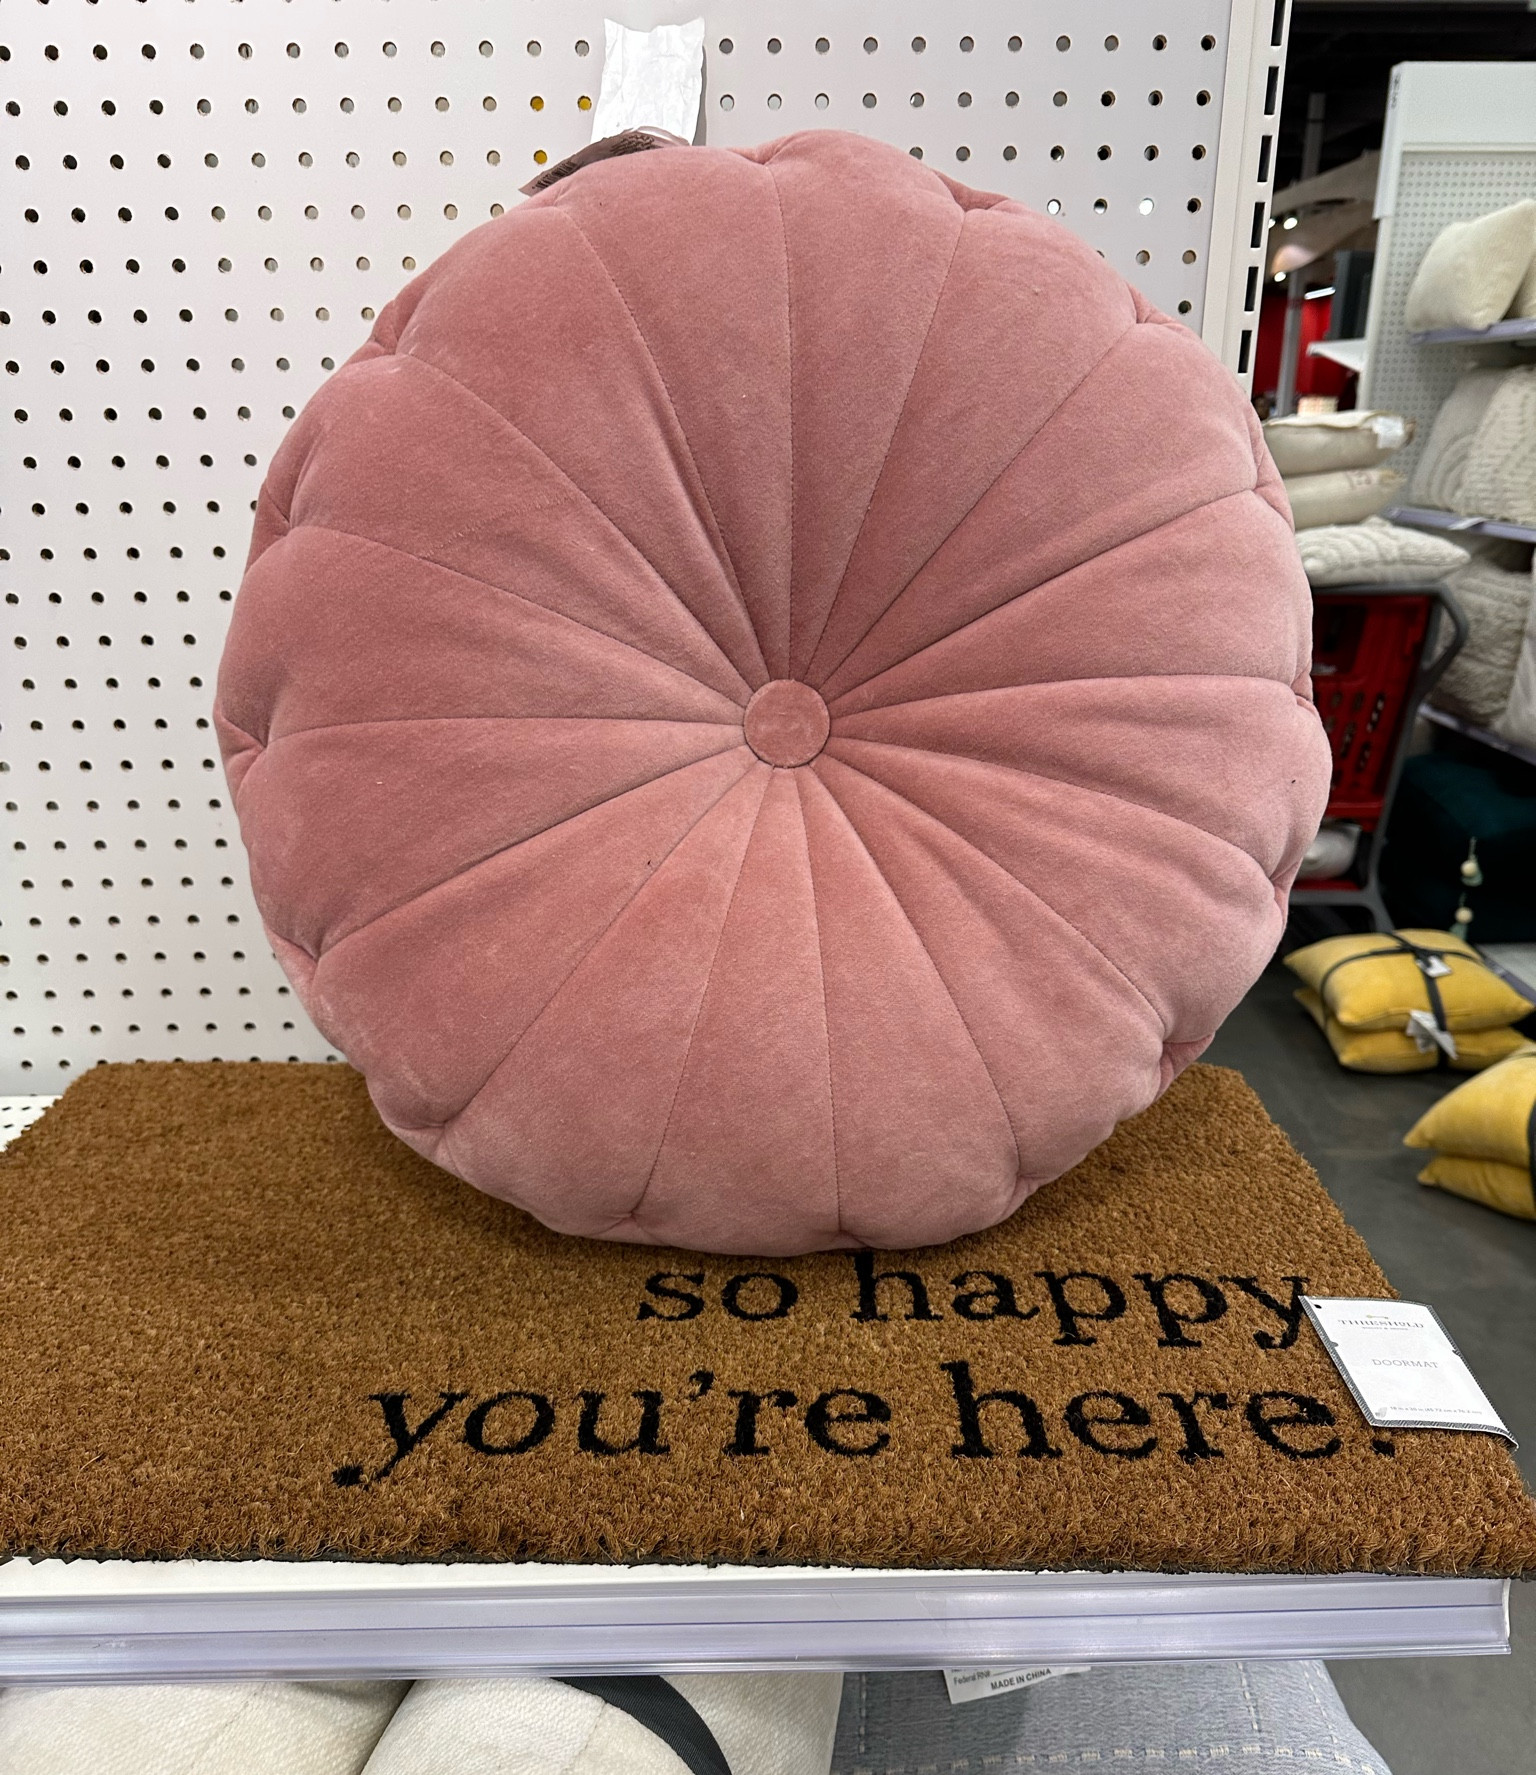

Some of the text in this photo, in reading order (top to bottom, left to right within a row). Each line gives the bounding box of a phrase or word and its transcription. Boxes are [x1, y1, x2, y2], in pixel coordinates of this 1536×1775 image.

[637, 1252, 1308, 1350] so happy
[1371, 1359, 1438, 1368] DOORMAT
[331, 1360, 1395, 1487] you're here.
[953, 1673, 976, 1685] Federal
[990, 1668, 1052, 1690] MADE IN CHINA
